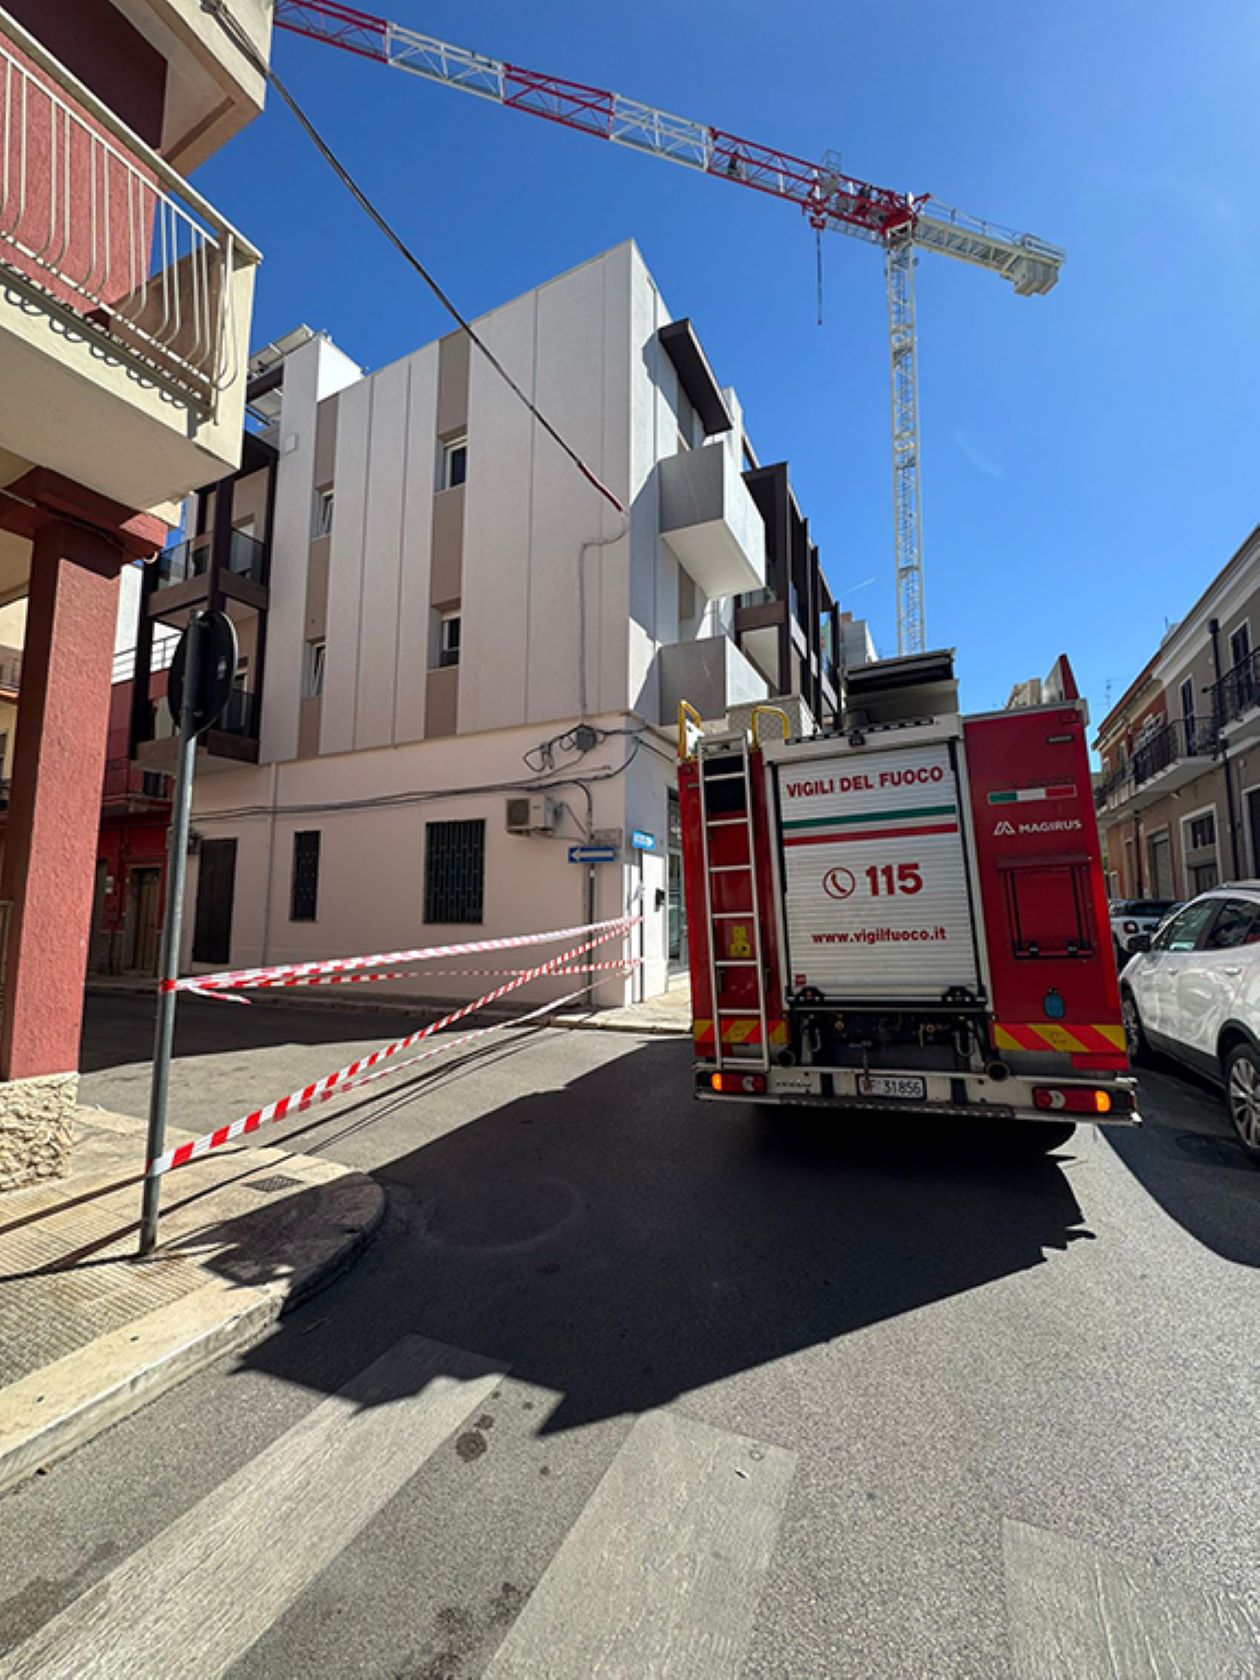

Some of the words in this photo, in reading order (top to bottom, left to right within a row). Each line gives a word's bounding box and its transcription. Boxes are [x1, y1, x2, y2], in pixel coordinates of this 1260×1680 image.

[786, 779, 834, 798] VIGILI
[839, 775, 874, 792] DEL
[879, 766, 944, 788] FUOCO
[1019, 819, 1082, 833] MAGIRUS
[865, 863, 923, 896] 115
[811, 926, 947, 944] www.vigilfuoco.it
